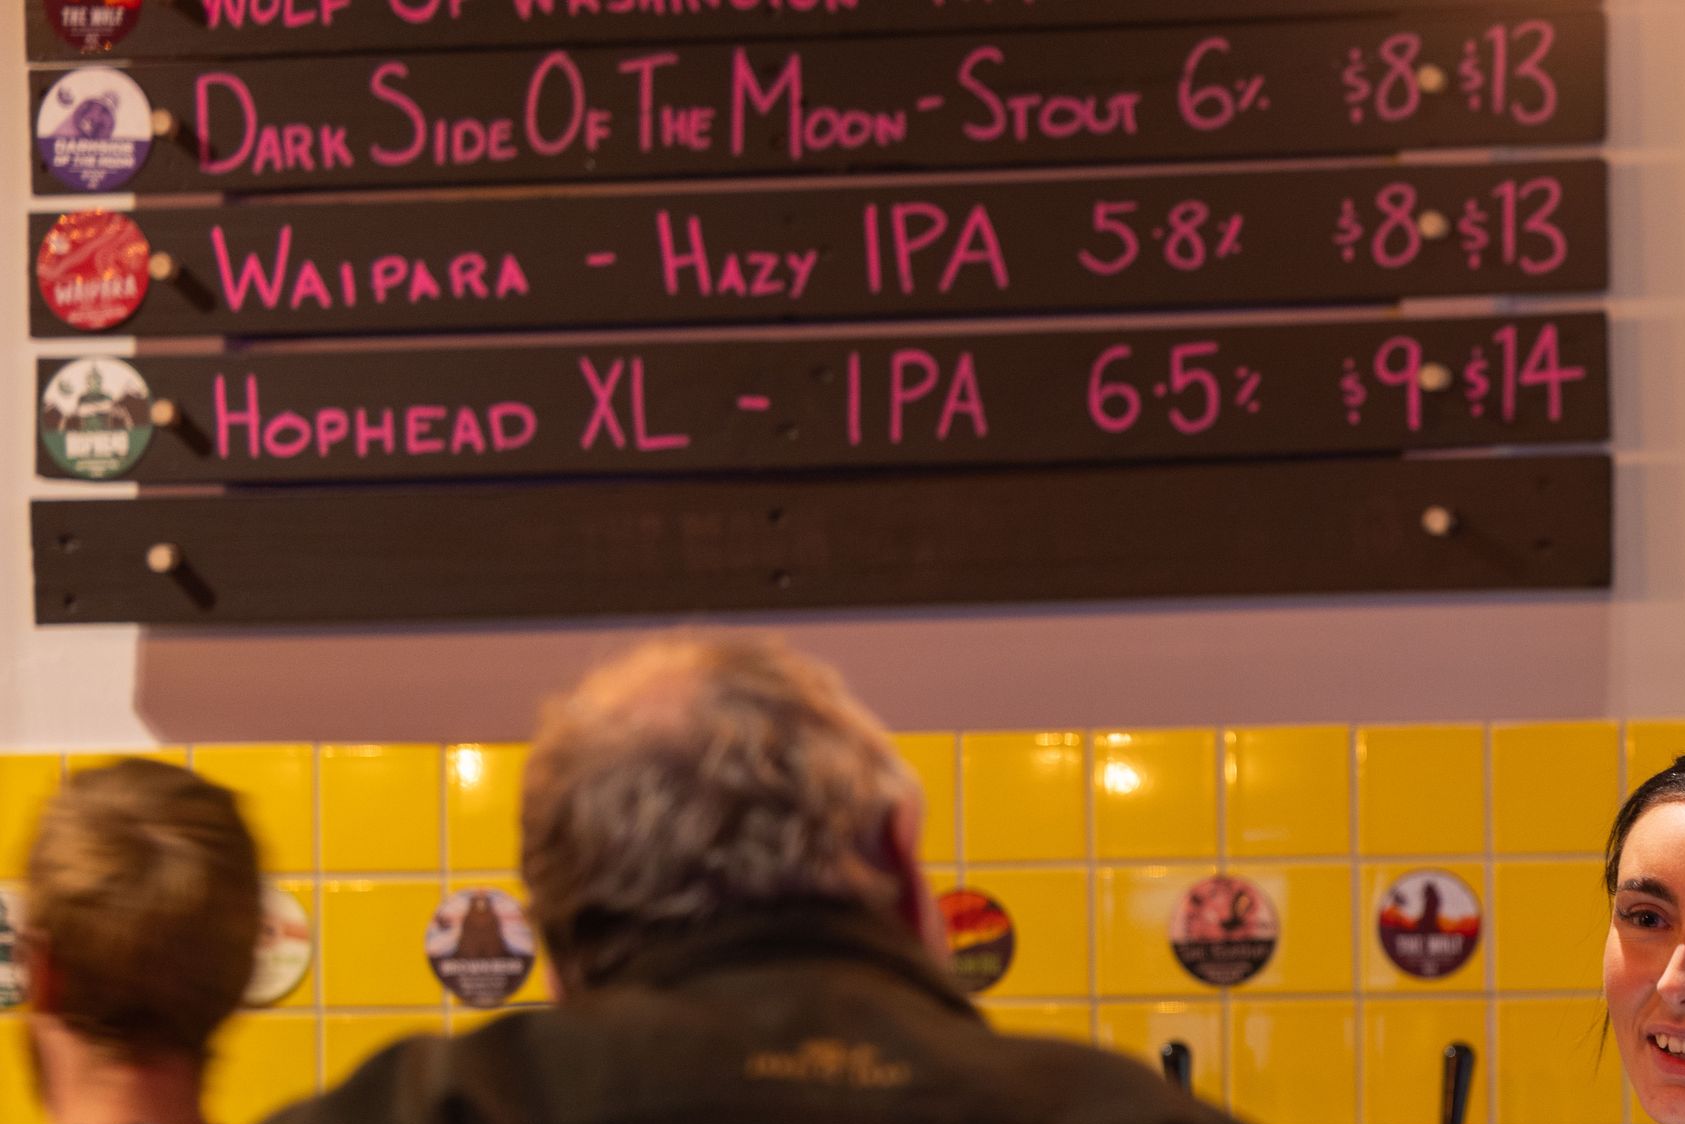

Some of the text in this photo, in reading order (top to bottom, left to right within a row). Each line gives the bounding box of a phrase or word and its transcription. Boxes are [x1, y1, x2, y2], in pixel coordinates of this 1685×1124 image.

[196, 72, 353, 174] DARK
[370, 62, 518, 166] SIDE
[526, 51, 611, 155] OF
[620, 53, 715, 152] THE
[731, 47, 907, 160] MOON
[957, 46, 1141, 141] STOUT
[1178, 38, 1270, 130] 6%
[1342, 33, 1422, 126] $8
[1457, 20, 1558, 126] $13
[211, 226, 531, 312] WAIPARA
[656, 210, 818, 299] HAZY
[863, 203, 1010, 294] IPA
[1335, 183, 1422, 269] $8
[1458, 178, 1568, 275] $13
[213, 374, 539, 459] HOPHEAD
[580, 357, 691, 450] XL
[1339, 336, 1425, 431] $9
[1464, 323, 1587, 424] $14
